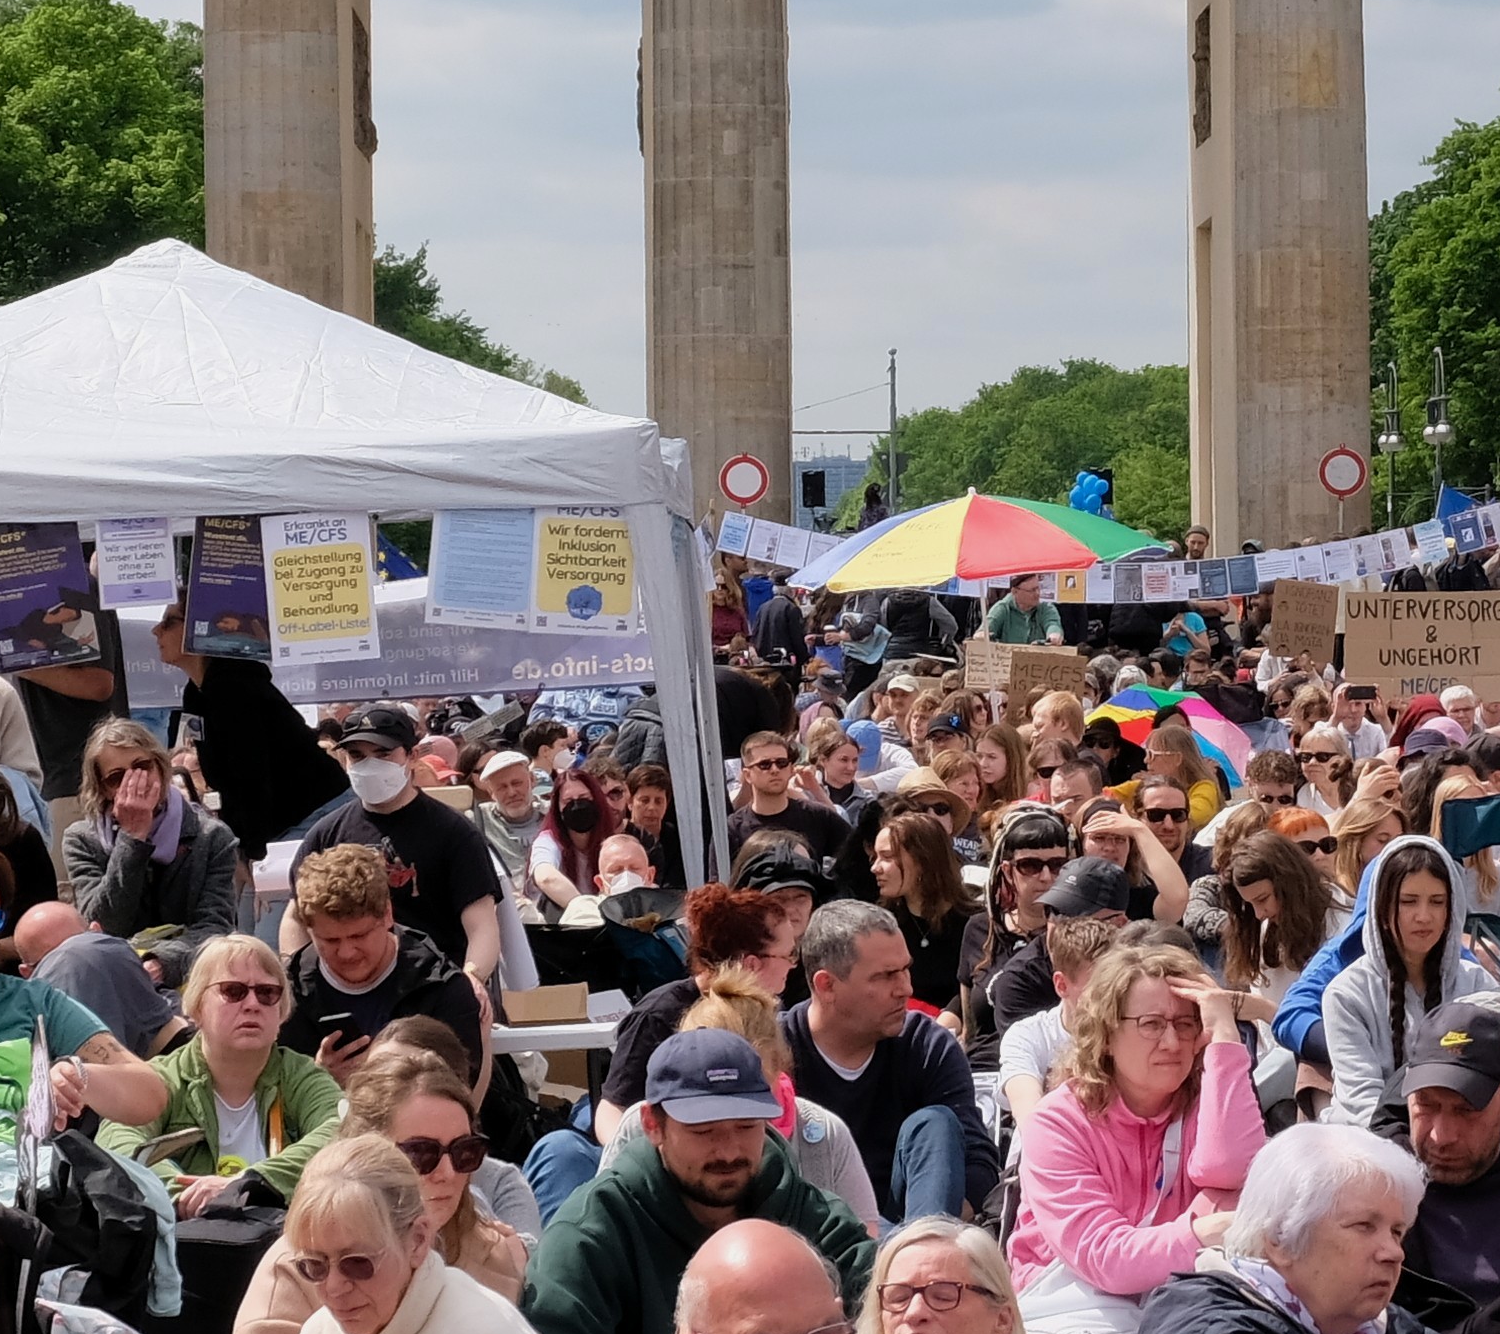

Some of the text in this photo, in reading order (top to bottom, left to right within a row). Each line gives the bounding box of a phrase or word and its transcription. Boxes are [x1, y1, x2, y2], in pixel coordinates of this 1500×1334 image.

[283, 518, 346, 531] Erkrankt an
[547, 524, 571, 536] Wir
[285, 528, 347, 545] ME/CFS
[104, 541, 165, 553] Wir verlieren
[558, 539, 616, 553] Inklusion
[105, 554, 133, 562] unser
[274, 552, 362, 567] Gleichstellung
[546, 553, 627, 568] Sichtbarkeit
[117, 563, 142, 571] ohne
[274, 564, 364, 580] bei Zugang zu
[546, 568, 626, 585] Versorgung
[282, 578, 358, 592] Versorgung
[309, 592, 333, 602] und
[283, 603, 359, 618] Behandlung
[277, 617, 370, 635] Off-Label-Liste!
[1425, 624, 1438, 644] &
[1379, 643, 1482, 667] UNGEHÖRT
[1013, 663, 1083, 683] ME/CFS
